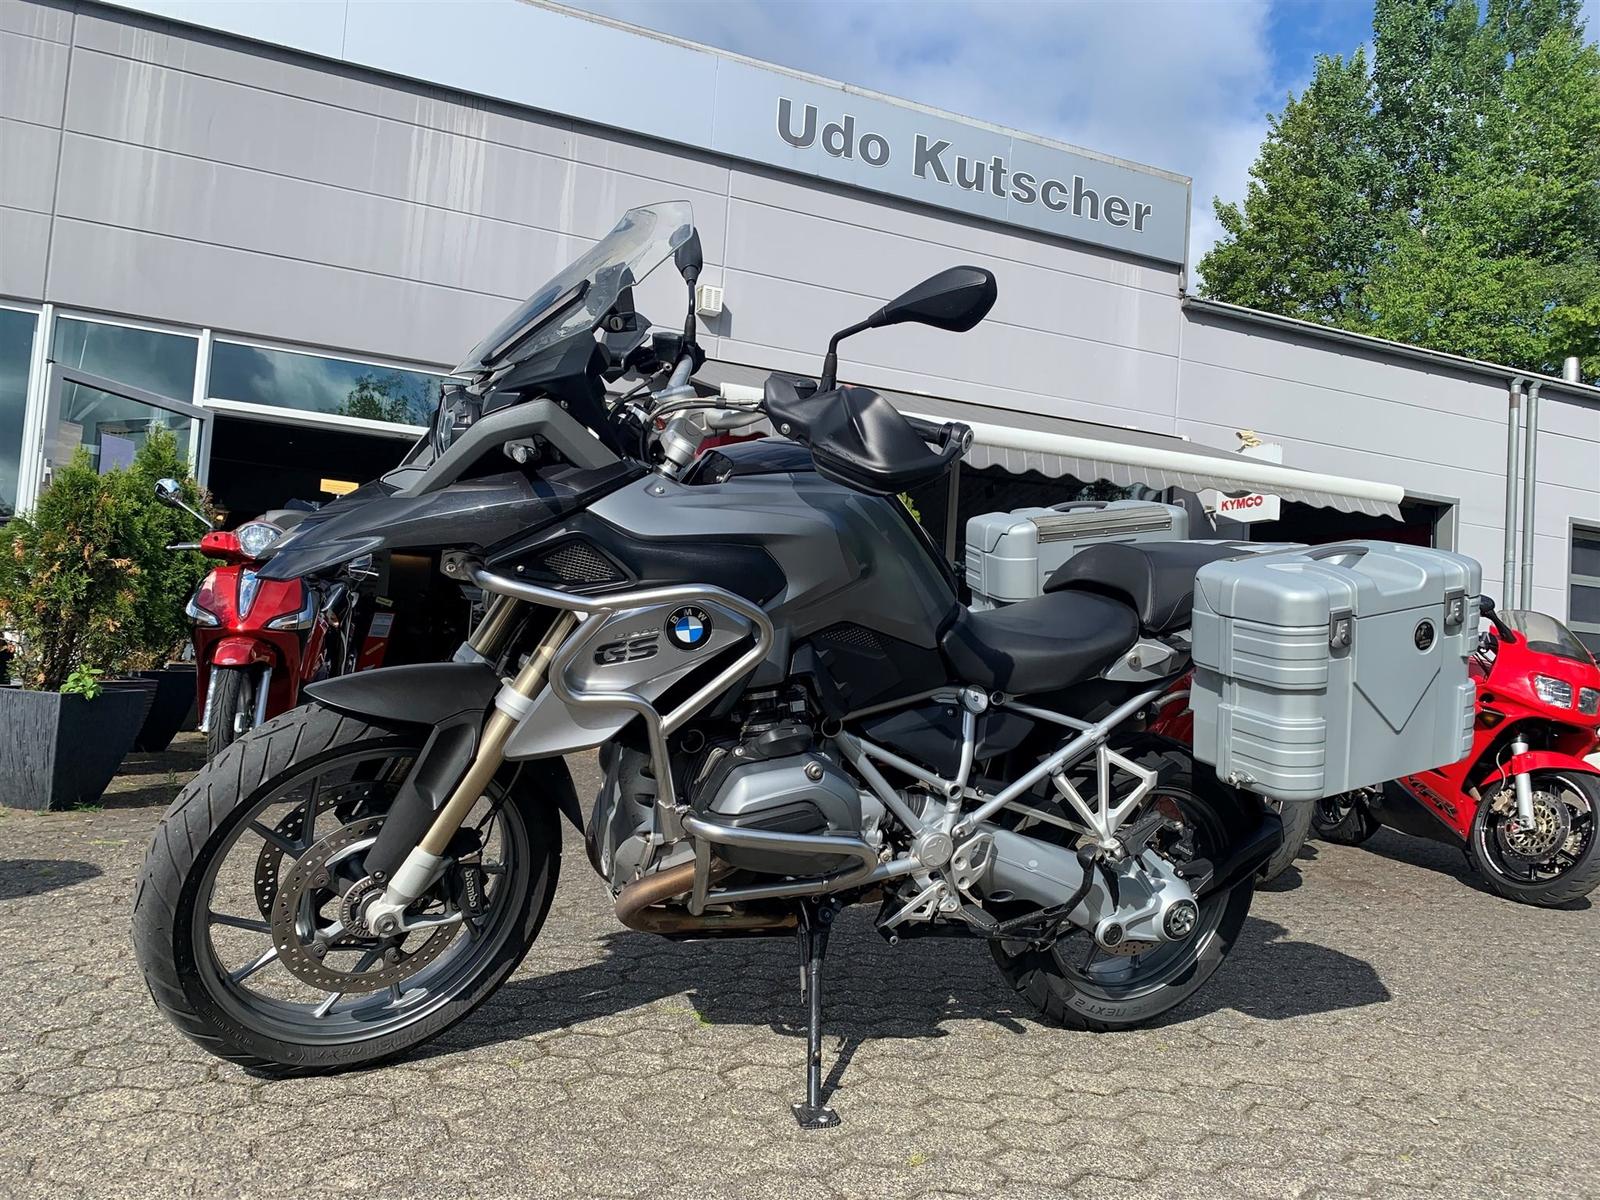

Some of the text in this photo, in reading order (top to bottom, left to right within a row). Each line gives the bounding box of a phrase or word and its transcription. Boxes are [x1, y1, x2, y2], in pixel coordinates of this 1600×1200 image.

[776, 95, 1153, 233] Udo Kutscher
[1220, 495, 1264, 511] KYMCO
[670, 608, 708, 624] BMW
[594, 635, 659, 665] GS
[464, 869, 478, 908] brembo
